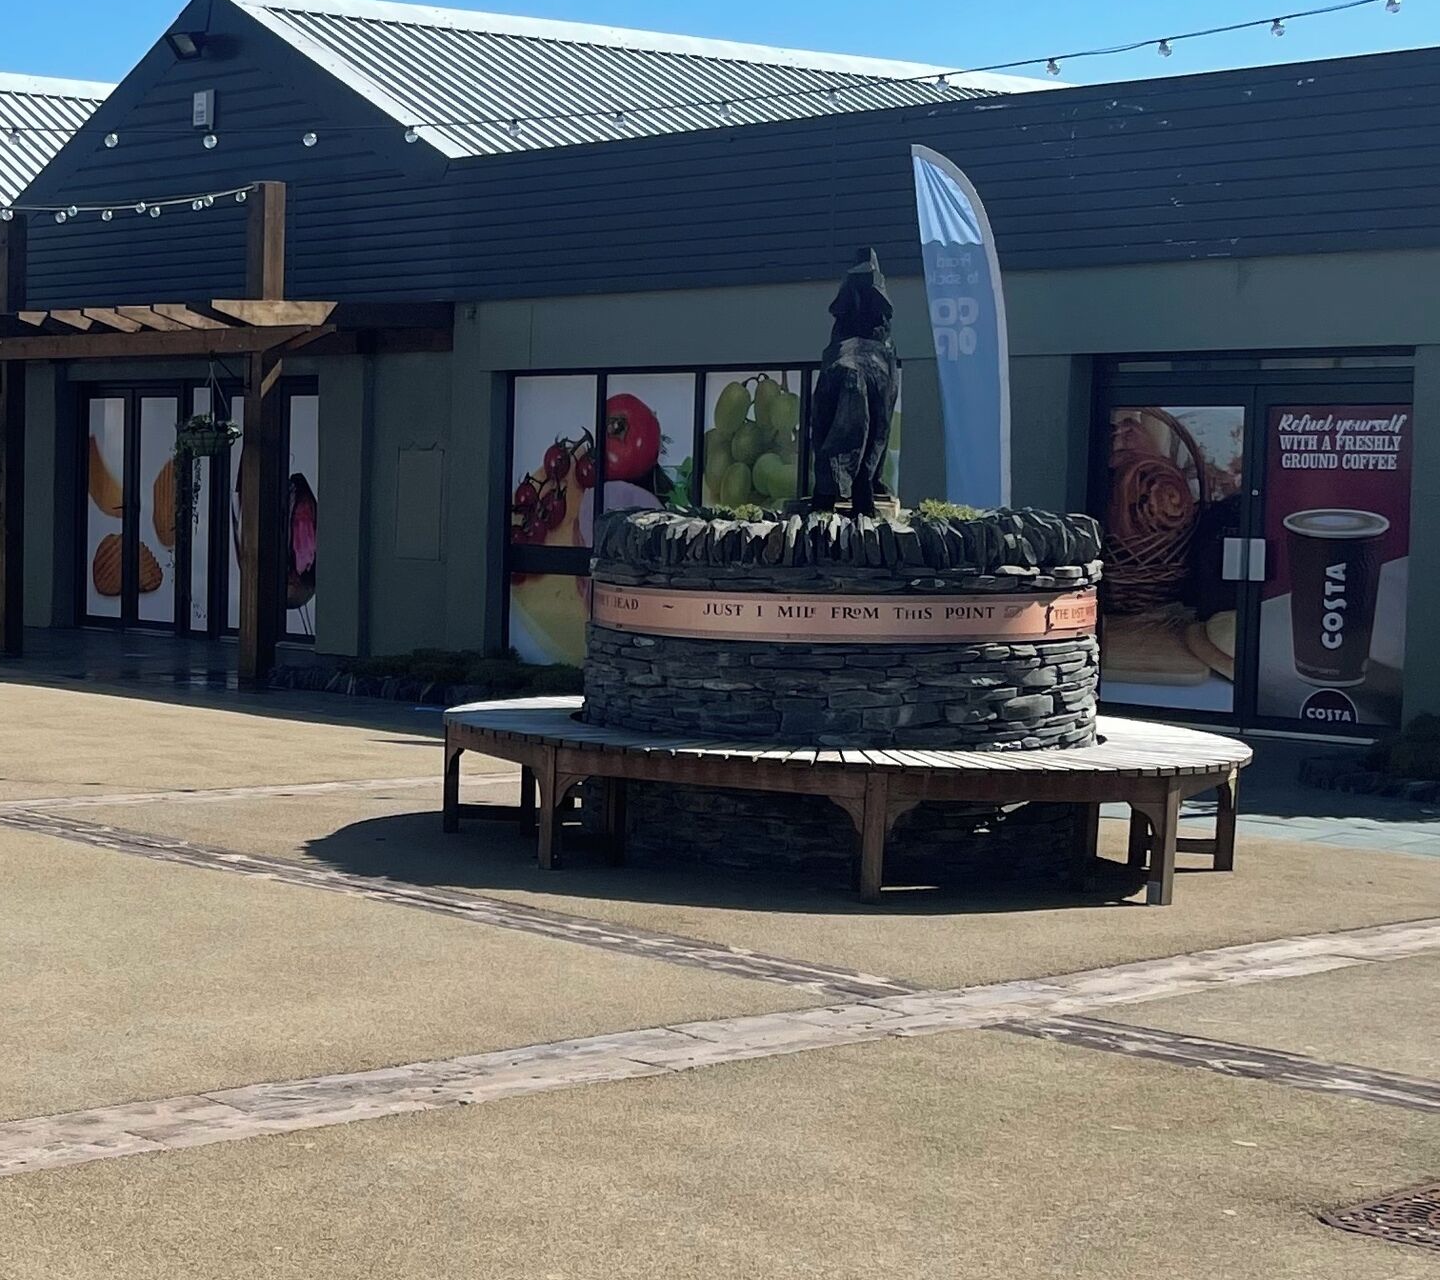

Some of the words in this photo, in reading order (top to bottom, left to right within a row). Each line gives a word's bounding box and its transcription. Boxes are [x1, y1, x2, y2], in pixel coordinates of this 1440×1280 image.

[1278, 414, 1334, 433] Refuel
[1336, 414, 1407, 437] yourself
[1279, 434, 1318, 450] WITH
[1321, 435, 1331, 450] A
[1336, 435, 1402, 451] FRESHLY
[1282, 453, 1338, 469] GROUND
[1342, 453, 1397, 470] COFFEE
[703, 603, 744, 616] JUST
[777, 606, 816, 618] MILE
[831, 607, 880, 620] FROM
[893, 607, 932, 620] THIS
[945, 607, 995, 619] POINT
[1321, 562, 1347, 649] COSTA
[1306, 707, 1351, 722] COSTA
